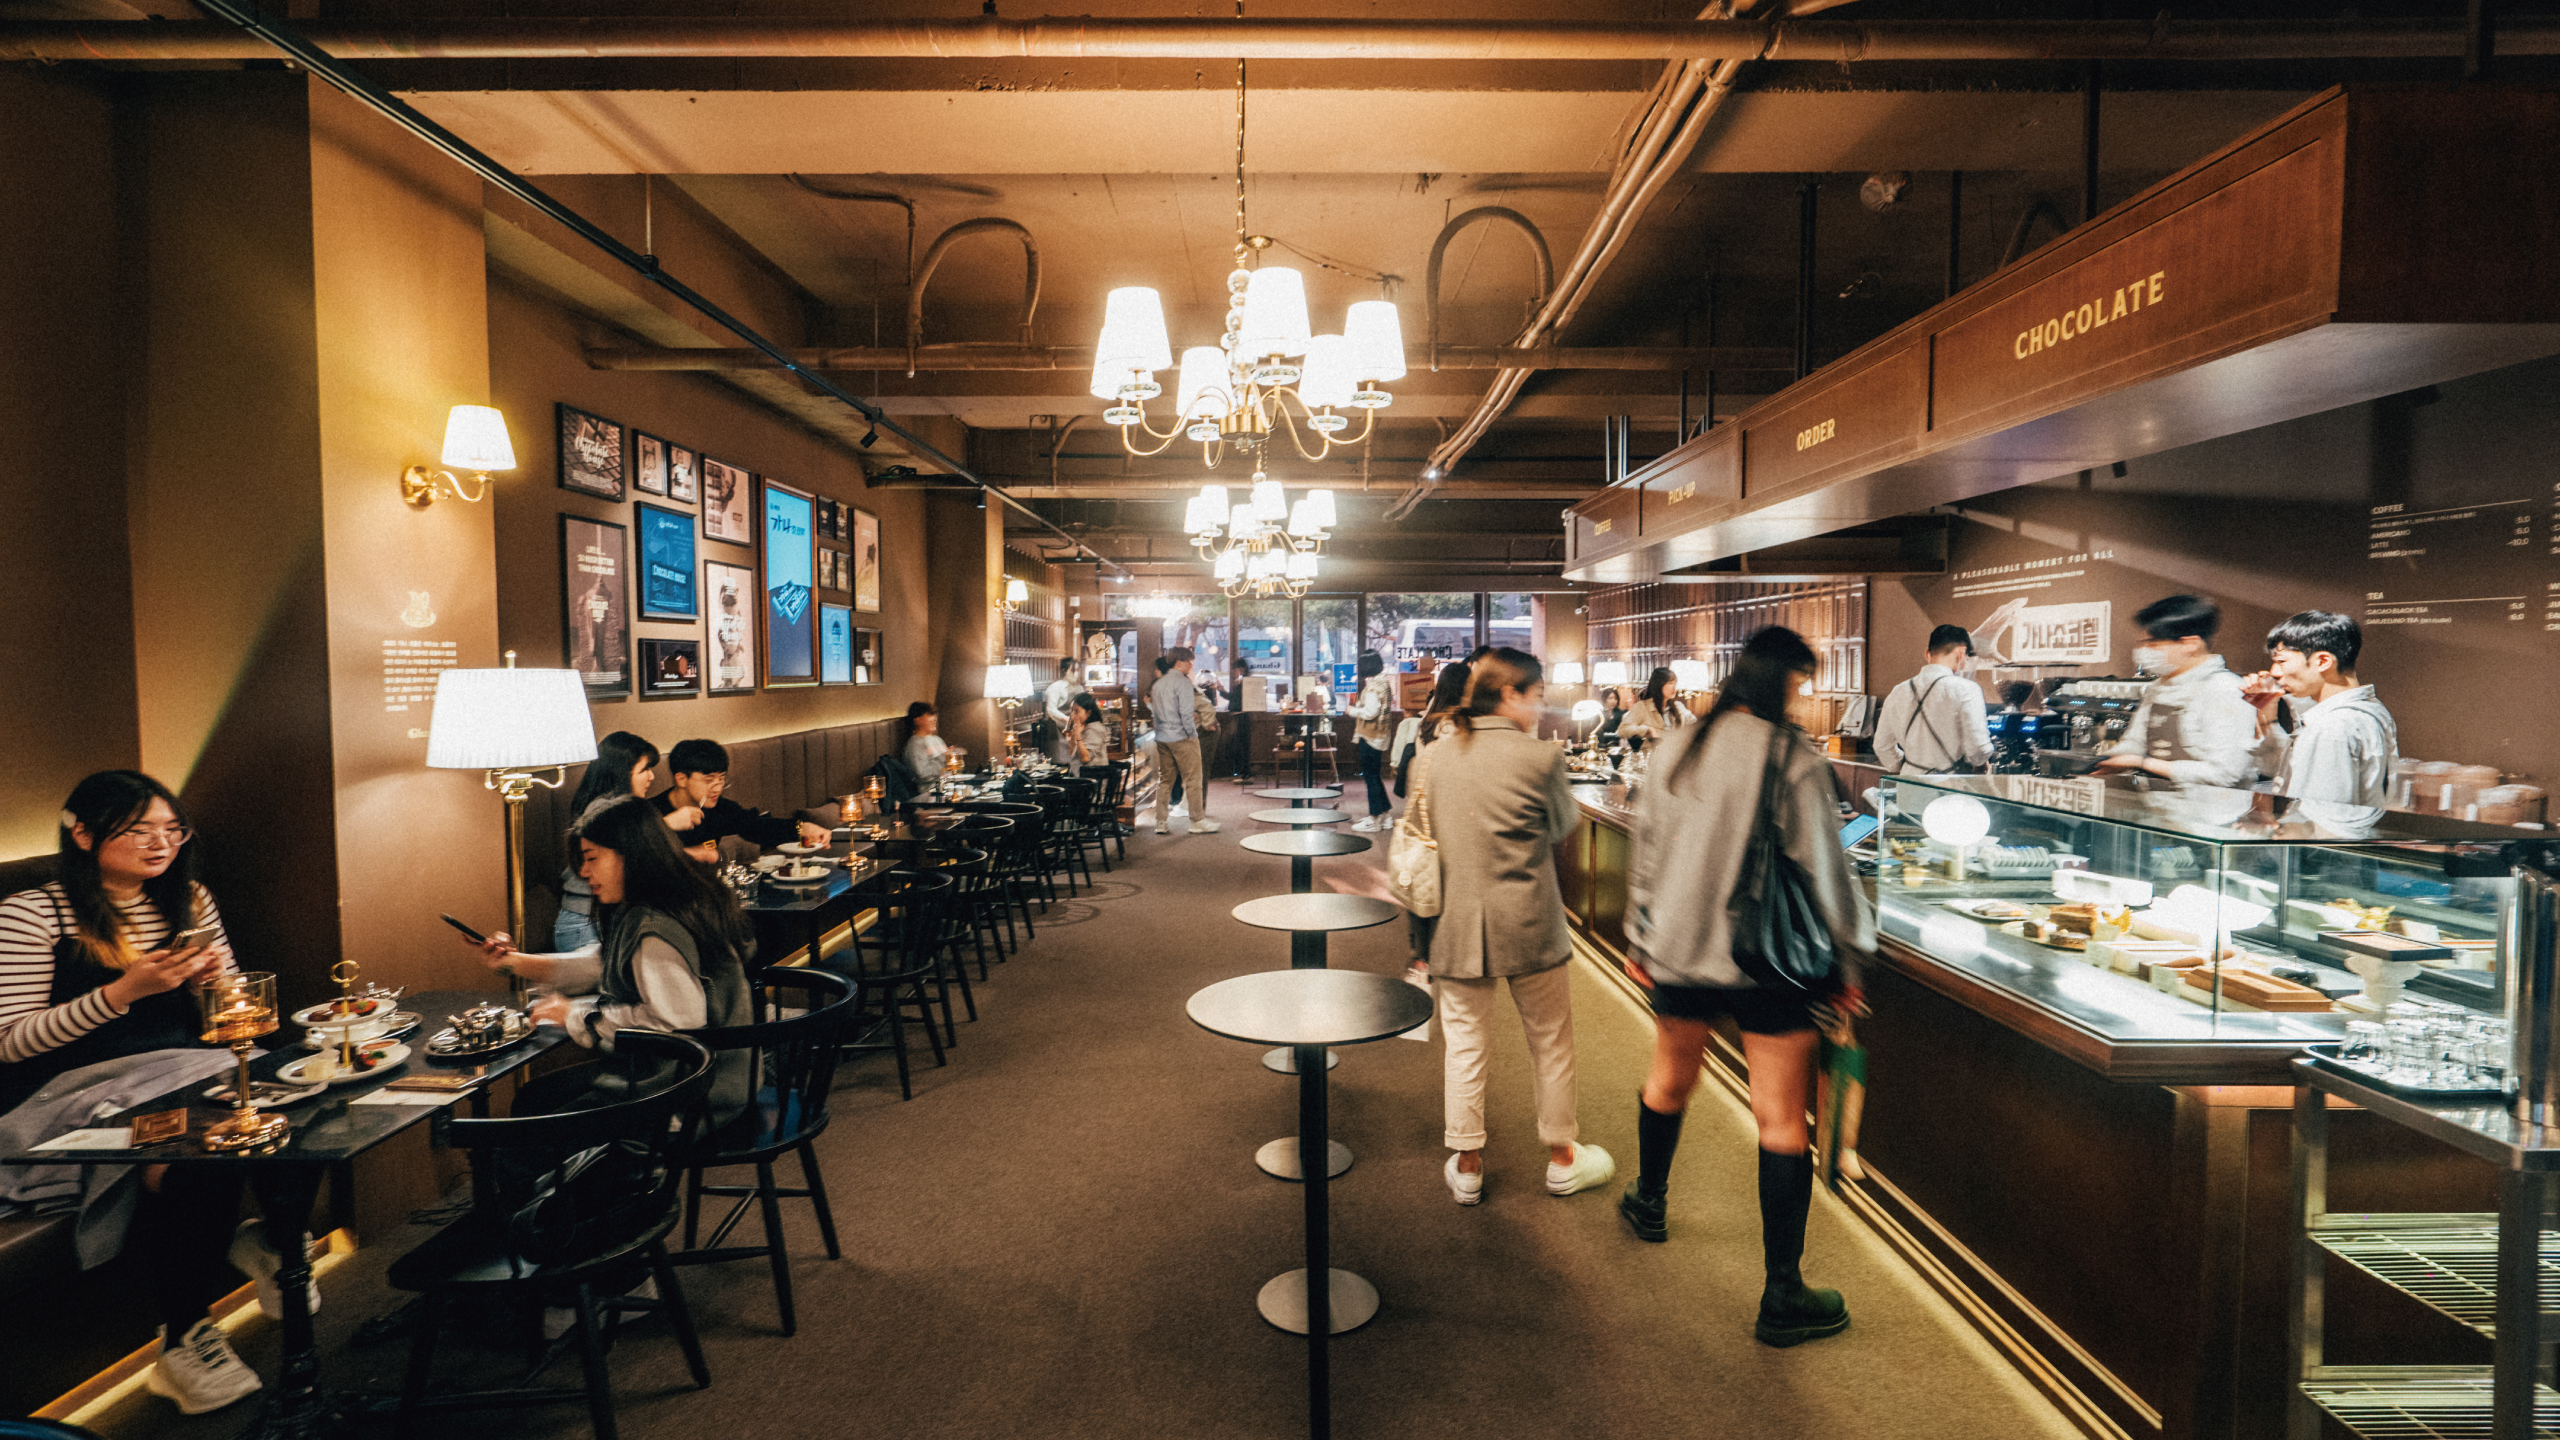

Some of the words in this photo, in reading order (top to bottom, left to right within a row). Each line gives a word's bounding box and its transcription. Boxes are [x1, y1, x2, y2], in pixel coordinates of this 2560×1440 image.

[2014, 270, 2164, 360] CHOCOLATE
[1796, 417, 1836, 452] ORDER
[1667, 480, 1696, 506] PICK-UP
[2371, 504, 2404, 514] COFFEE
[1594, 518, 1612, 536] COFFEE
[2371, 529, 2411, 539] AMERICANO
[2370, 541, 2390, 549] LATTE
[1953, 572, 1959, 581] A
[1961, 563, 2021, 580] PLEASURABLE
[2024, 556, 2064, 570] MOMENT
[2068, 553, 2088, 564] FOR
[2093, 549, 2114, 561] ALL
[2366, 591, 2384, 600] TEA
[2392, 607, 2414, 615] BLACK
[2511, 602, 2526, 610] 5.0
[2406, 616, 2419, 624] TEA
